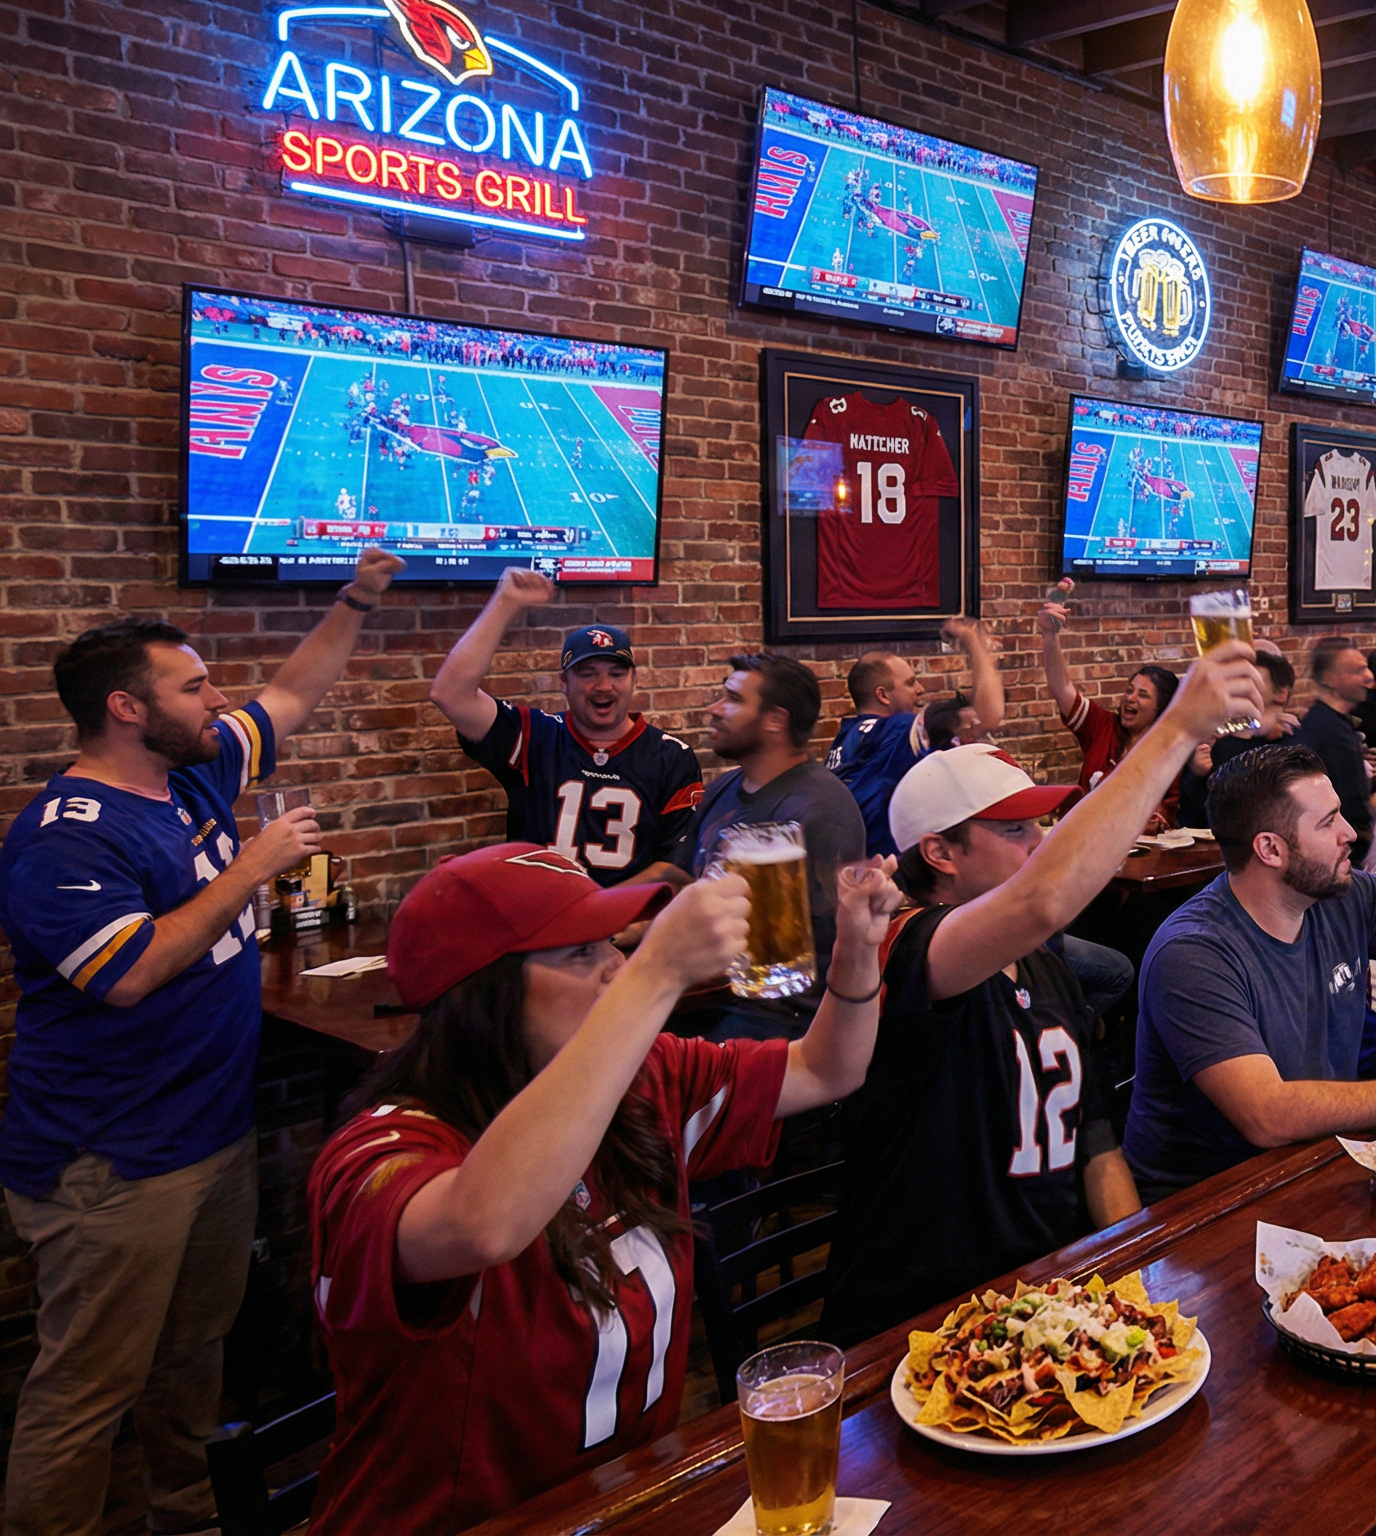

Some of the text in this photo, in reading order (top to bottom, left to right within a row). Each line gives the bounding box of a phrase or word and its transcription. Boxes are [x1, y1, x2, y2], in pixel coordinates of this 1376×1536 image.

[262, 51, 593, 179] ARIZONA
[281, 130, 589, 225] SPORTS GRILL
[856, 461, 907, 525] 18
[1330, 496, 1361, 542] 23
[40, 796, 102, 828] 13
[547, 780, 642, 870] 13
[1008, 1025, 1083, 1178] 12
